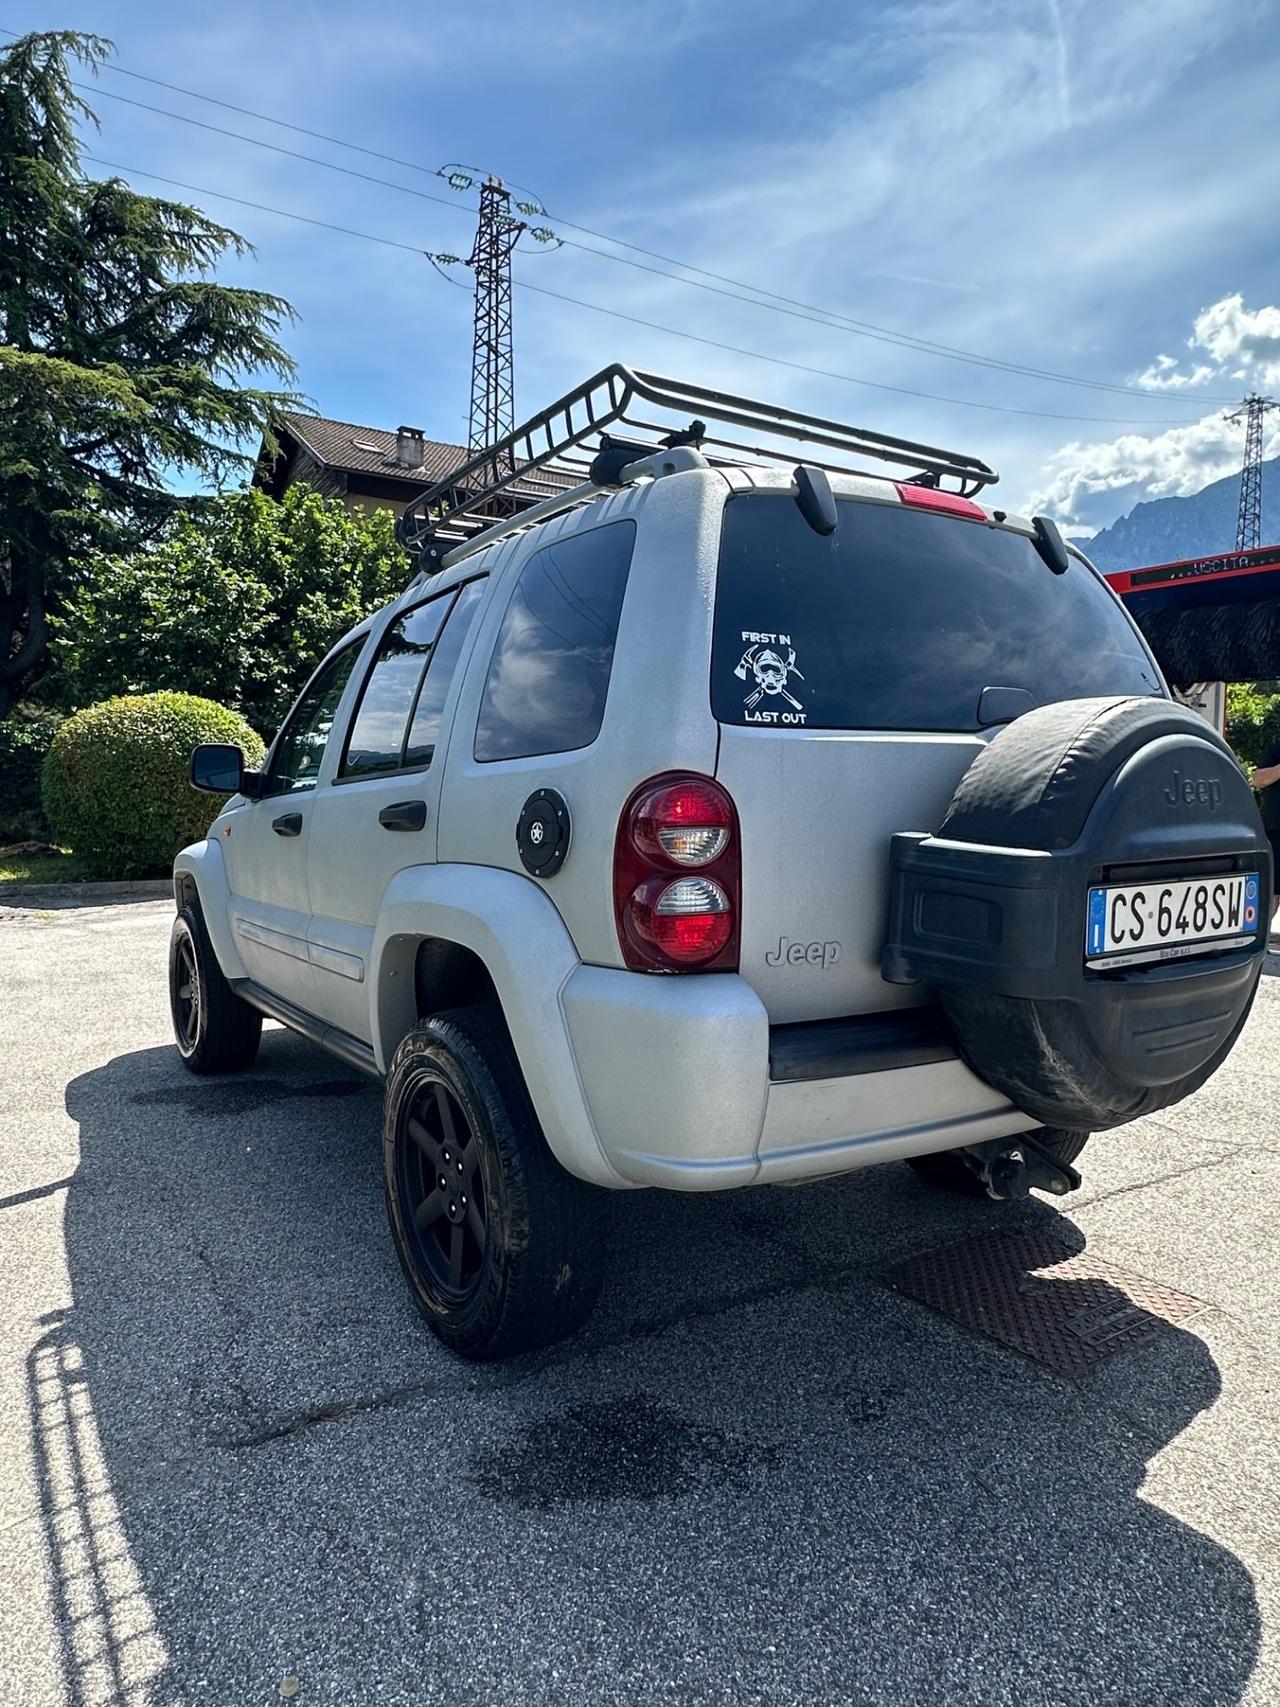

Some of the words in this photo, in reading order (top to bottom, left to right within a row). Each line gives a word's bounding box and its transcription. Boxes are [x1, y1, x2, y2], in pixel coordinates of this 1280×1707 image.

[741, 631, 777, 644] FIRST
[779, 634, 791, 645] IN
[744, 710, 779, 723] LAST
[781, 712, 807, 724] OUT
[1163, 769, 1221, 812] Jeep
[1110, 891, 1146, 944] CS
[1157, 881, 1242, 937] 648SW
[765, 936, 842, 970] Jeep
